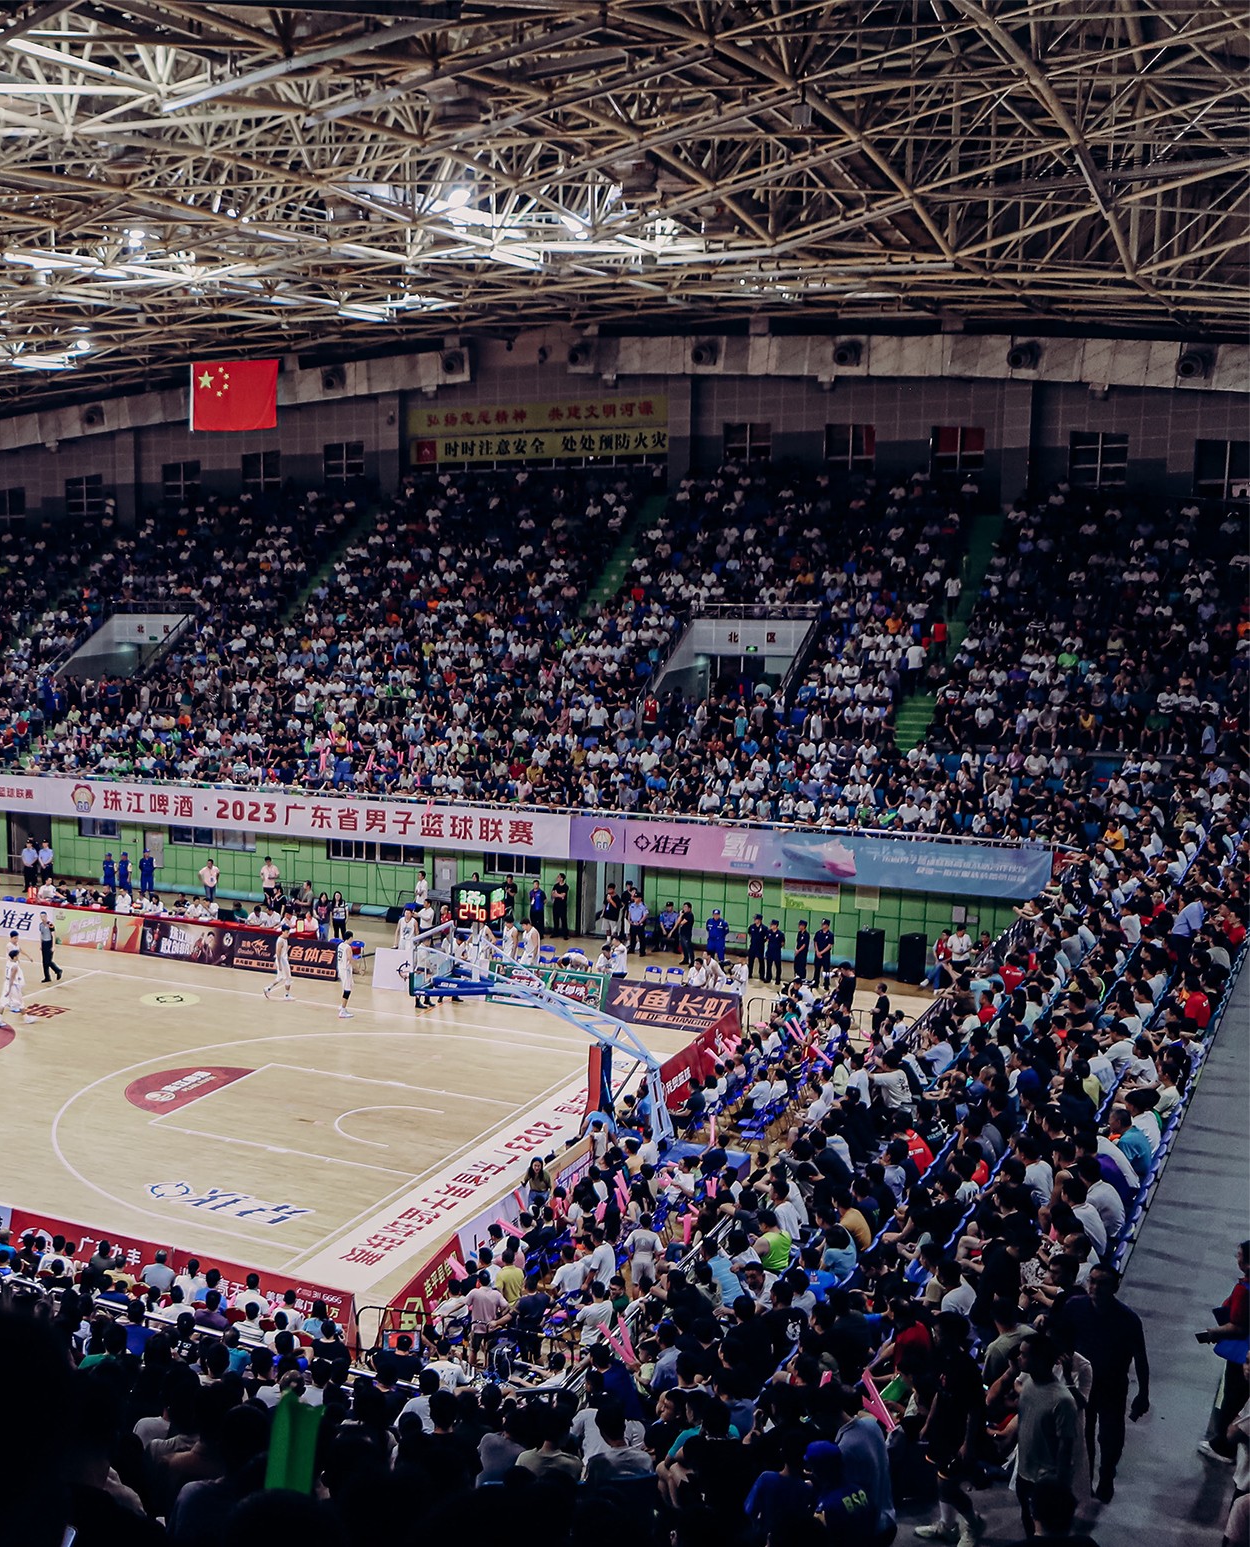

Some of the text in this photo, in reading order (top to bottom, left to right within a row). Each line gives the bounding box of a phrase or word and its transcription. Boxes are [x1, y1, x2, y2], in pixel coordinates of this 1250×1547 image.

[444, 431, 669, 457] 时时注意安全 处处预防火灾
[650, 834, 692, 856] 准者
[0, 909, 35, 931] 准者
[288, 945, 336, 965] 鱼体育
[611, 985, 733, 1019] 双鱼·长虹
[77, 1236, 143, 1266] 广力丰
[322, 1293, 343, 1304] 6666
